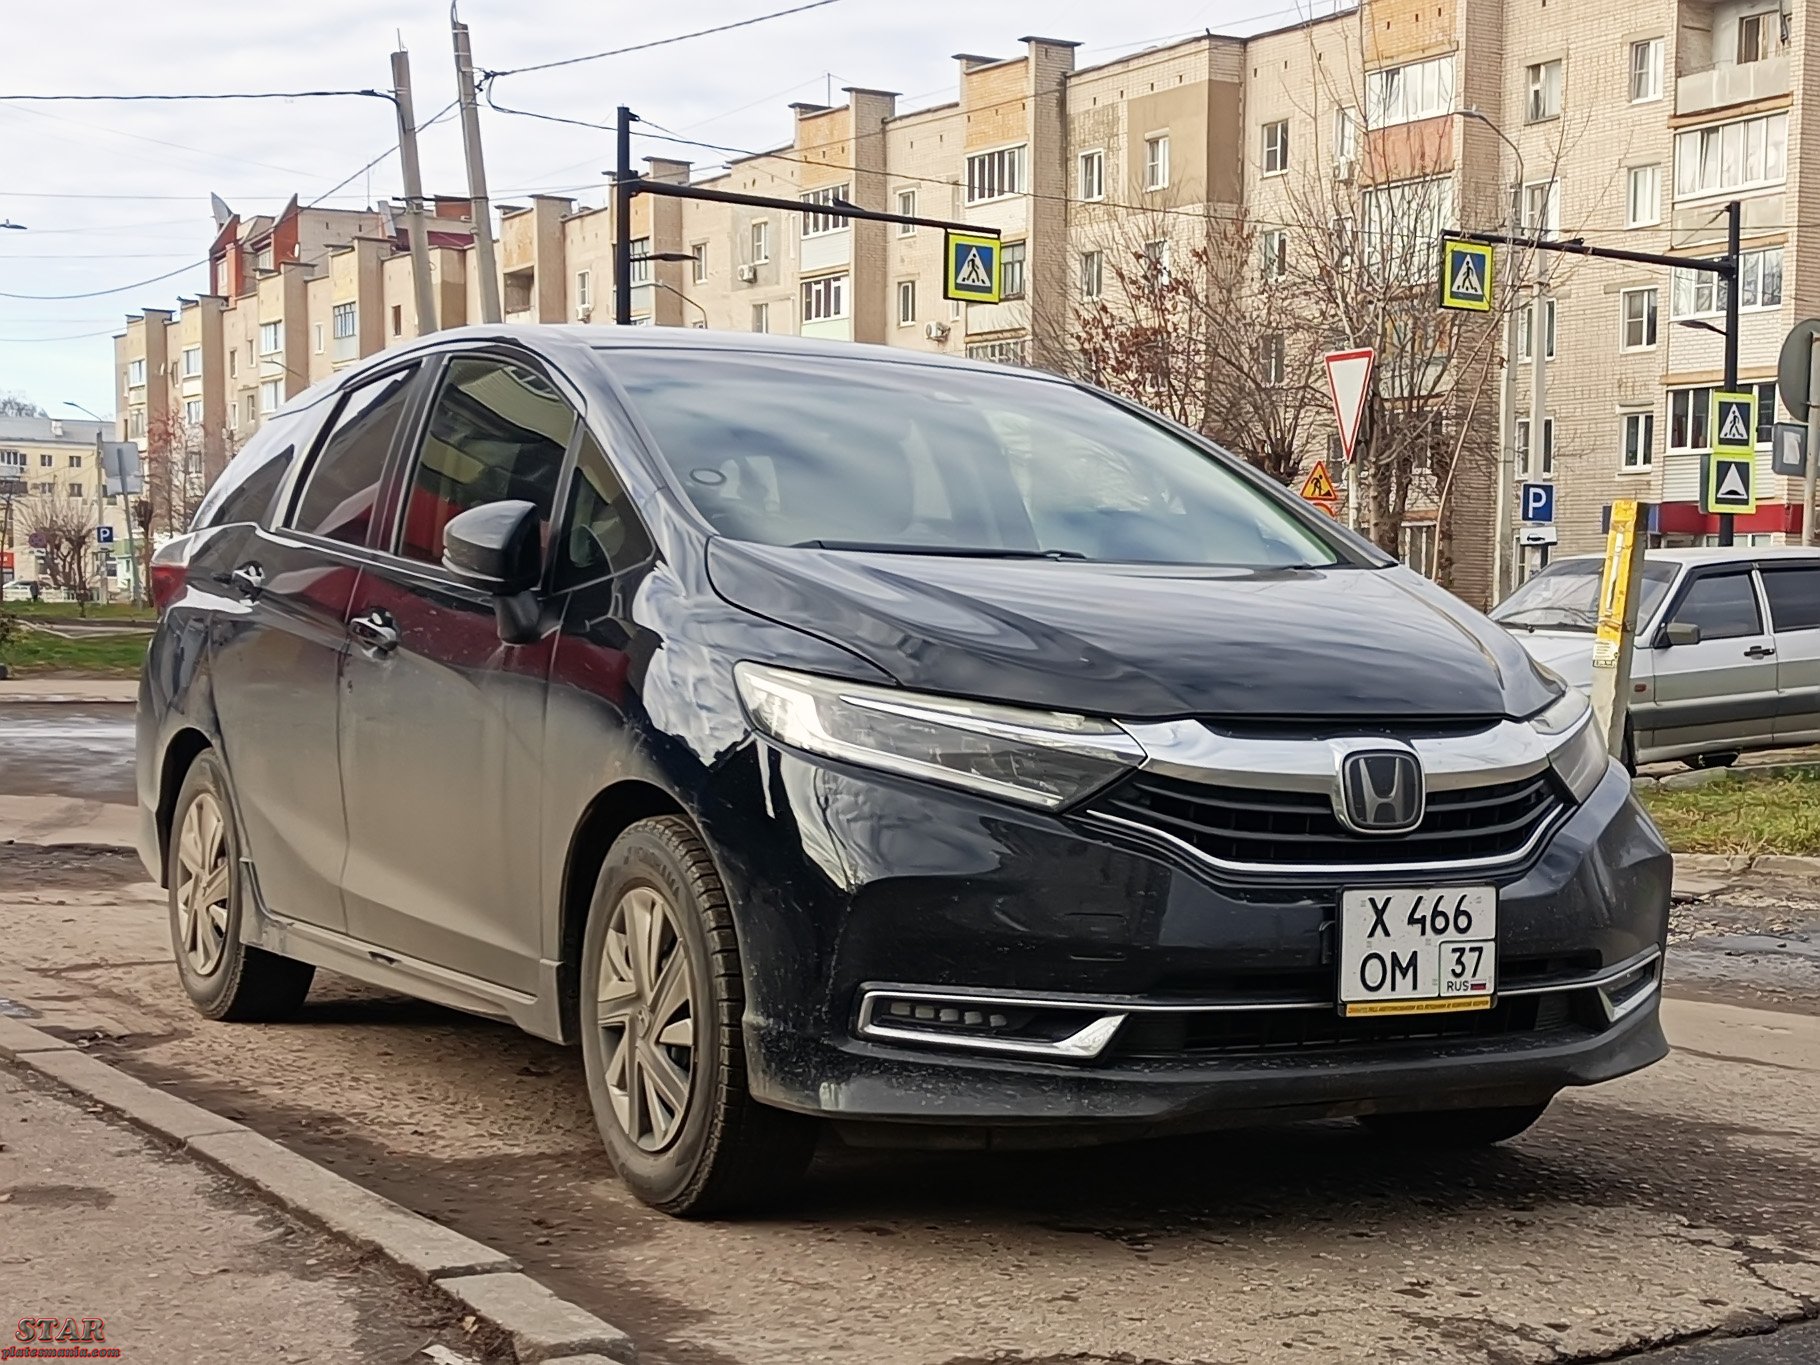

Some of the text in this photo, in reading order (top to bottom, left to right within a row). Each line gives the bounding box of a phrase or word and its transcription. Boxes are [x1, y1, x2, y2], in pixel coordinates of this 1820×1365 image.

[1528, 487, 1547, 519] P
[100, 528, 110, 542] P
[1407, 894, 1473, 936] 466
[1450, 946, 1484, 978] 37
[1446, 980, 1470, 992] RUS
